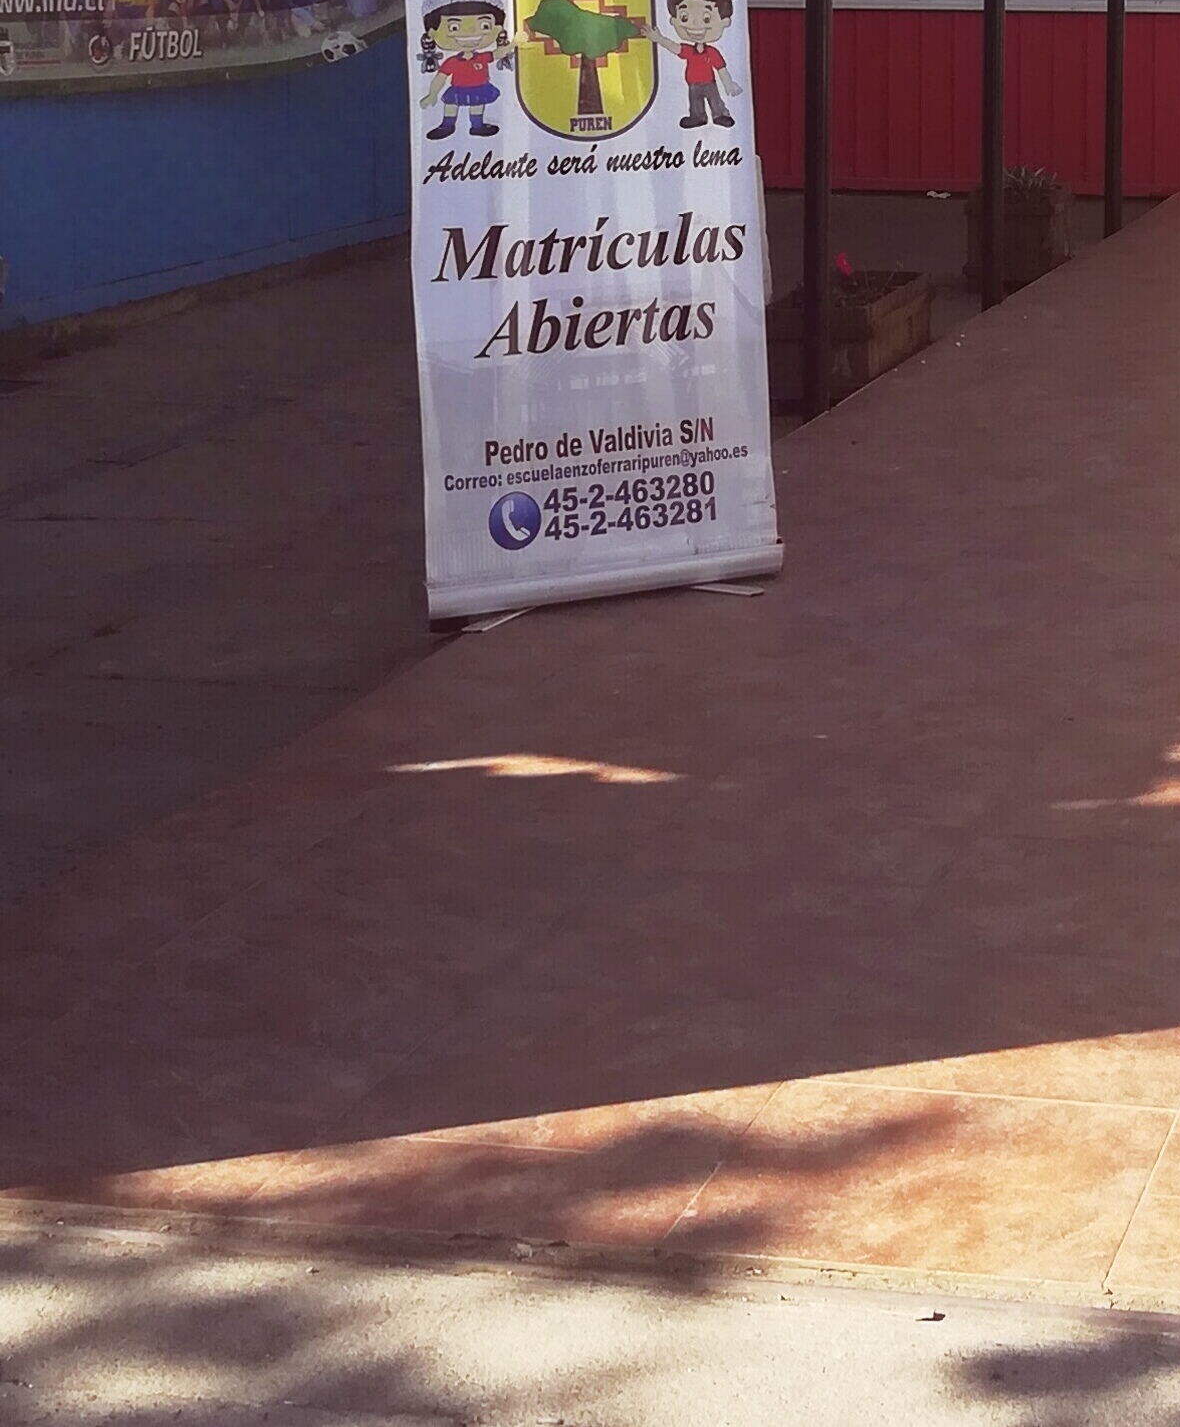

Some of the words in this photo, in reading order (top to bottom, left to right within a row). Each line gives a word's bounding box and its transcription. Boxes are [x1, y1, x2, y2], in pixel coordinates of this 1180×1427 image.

[129, 27, 204, 62] FÚTBOL
[569, 116, 613, 132] PUREN
[422, 150, 538, 185] Adelante
[547, 144, 599, 175] será
[606, 145, 686, 171] nuestro
[692, 140, 744, 168] lema
[431, 211, 747, 283] Matrículas
[474, 296, 716, 359] Abiertas
[484, 439, 549, 466] Pedro
[556, 433, 583, 458] de
[589, 423, 674, 454] Valdivia
[679, 417, 715, 445] S/N
[444, 473, 503, 491] Correo:
[506, 442, 749, 486] escuelaenzoferraripuren@yahoo.es
[543, 471, 715, 513] 45-2-463280
[544, 496, 717, 541] 45-2-463281
